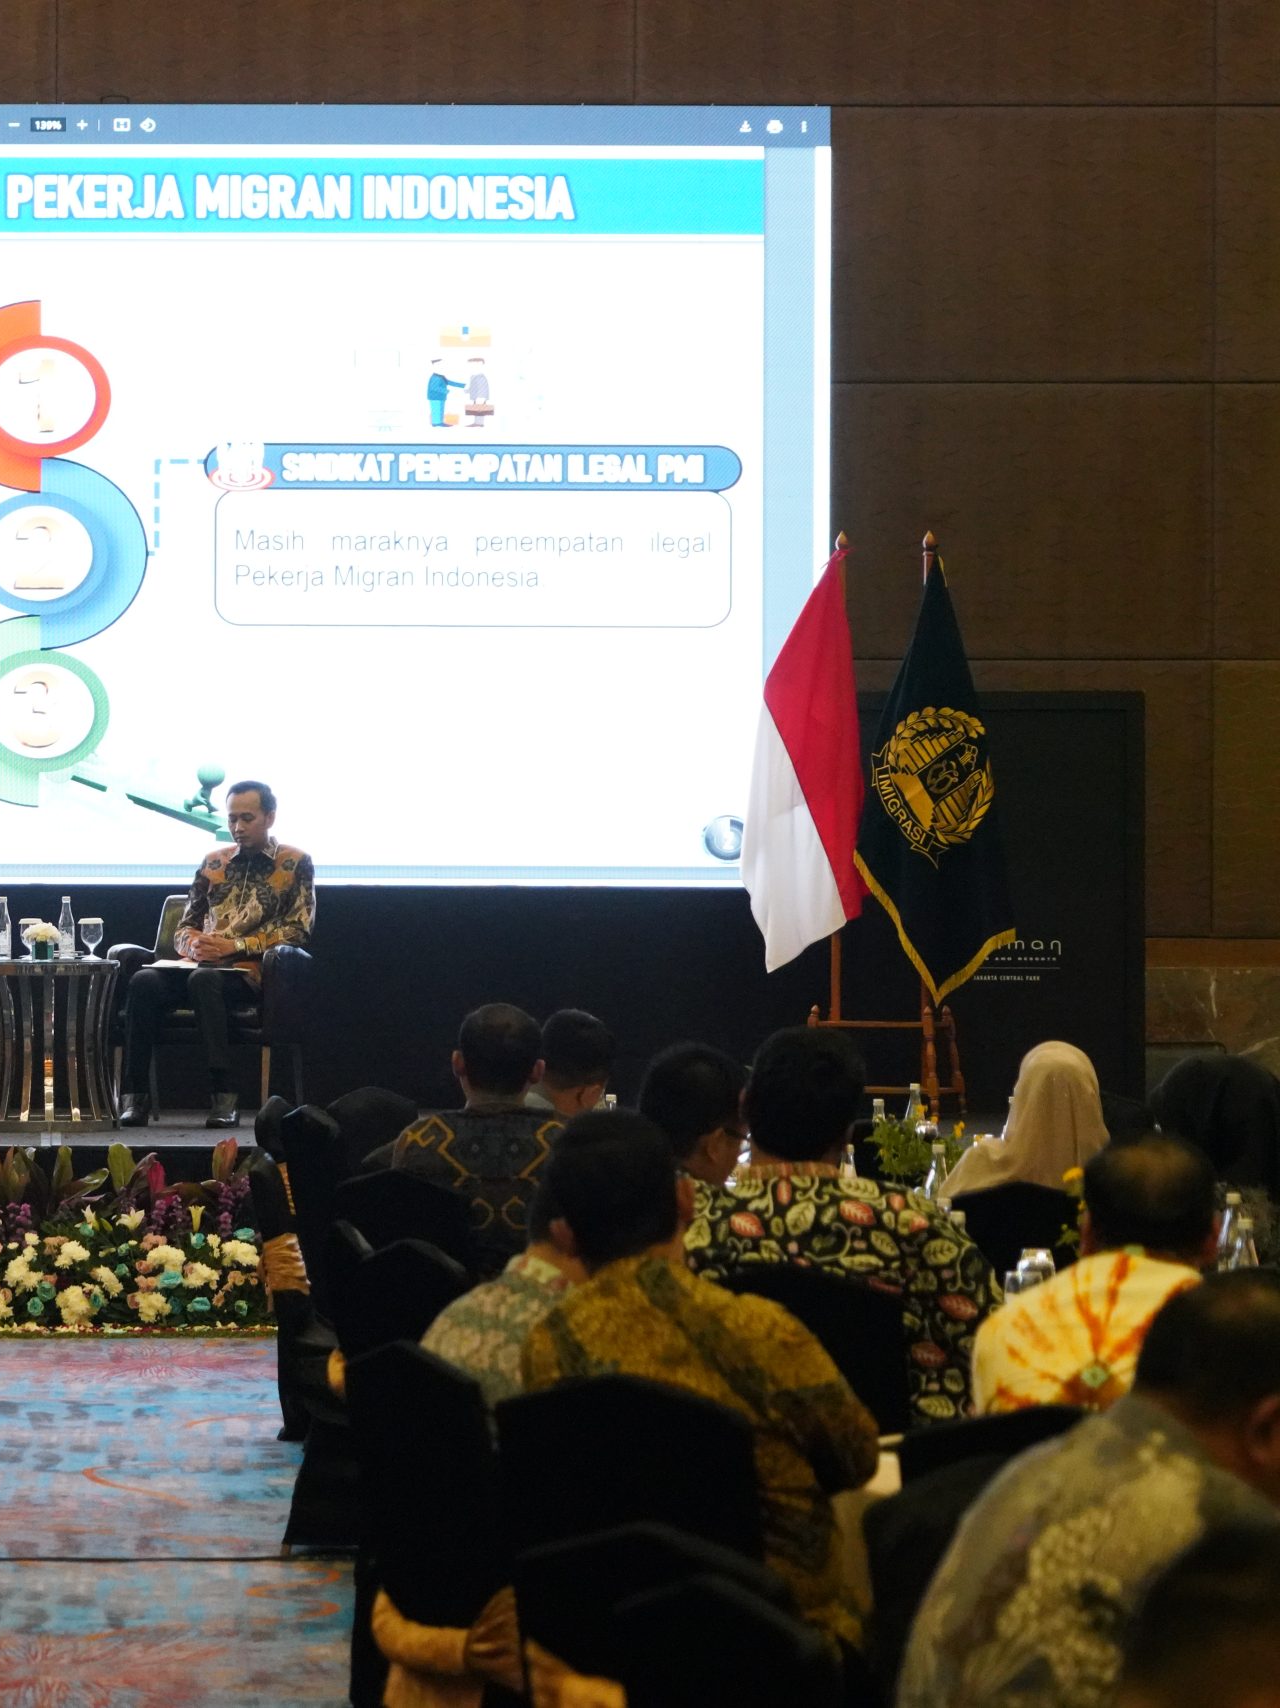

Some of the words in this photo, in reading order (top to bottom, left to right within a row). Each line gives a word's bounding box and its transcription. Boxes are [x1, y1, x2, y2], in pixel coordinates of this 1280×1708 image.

[8, 175, 183, 218] PEKERJA
[196, 175, 350, 218] MIGRAN
[364, 176, 574, 219] INDONESIA
[283, 454, 394, 480] SINDIKAT
[400, 454, 561, 481] PENEMPATAN
[568, 455, 652, 482] ILEGAL
[658, 455, 703, 482] PMI
[236, 529, 303, 550] Masih
[332, 531, 448, 557] maraknya
[476, 533, 622, 556] penempatan
[652, 533, 710, 558] ilegal
[236, 565, 323, 592] Pekerja
[335, 565, 413, 592] Migran
[878, 774, 926, 845] IMIGRASI
